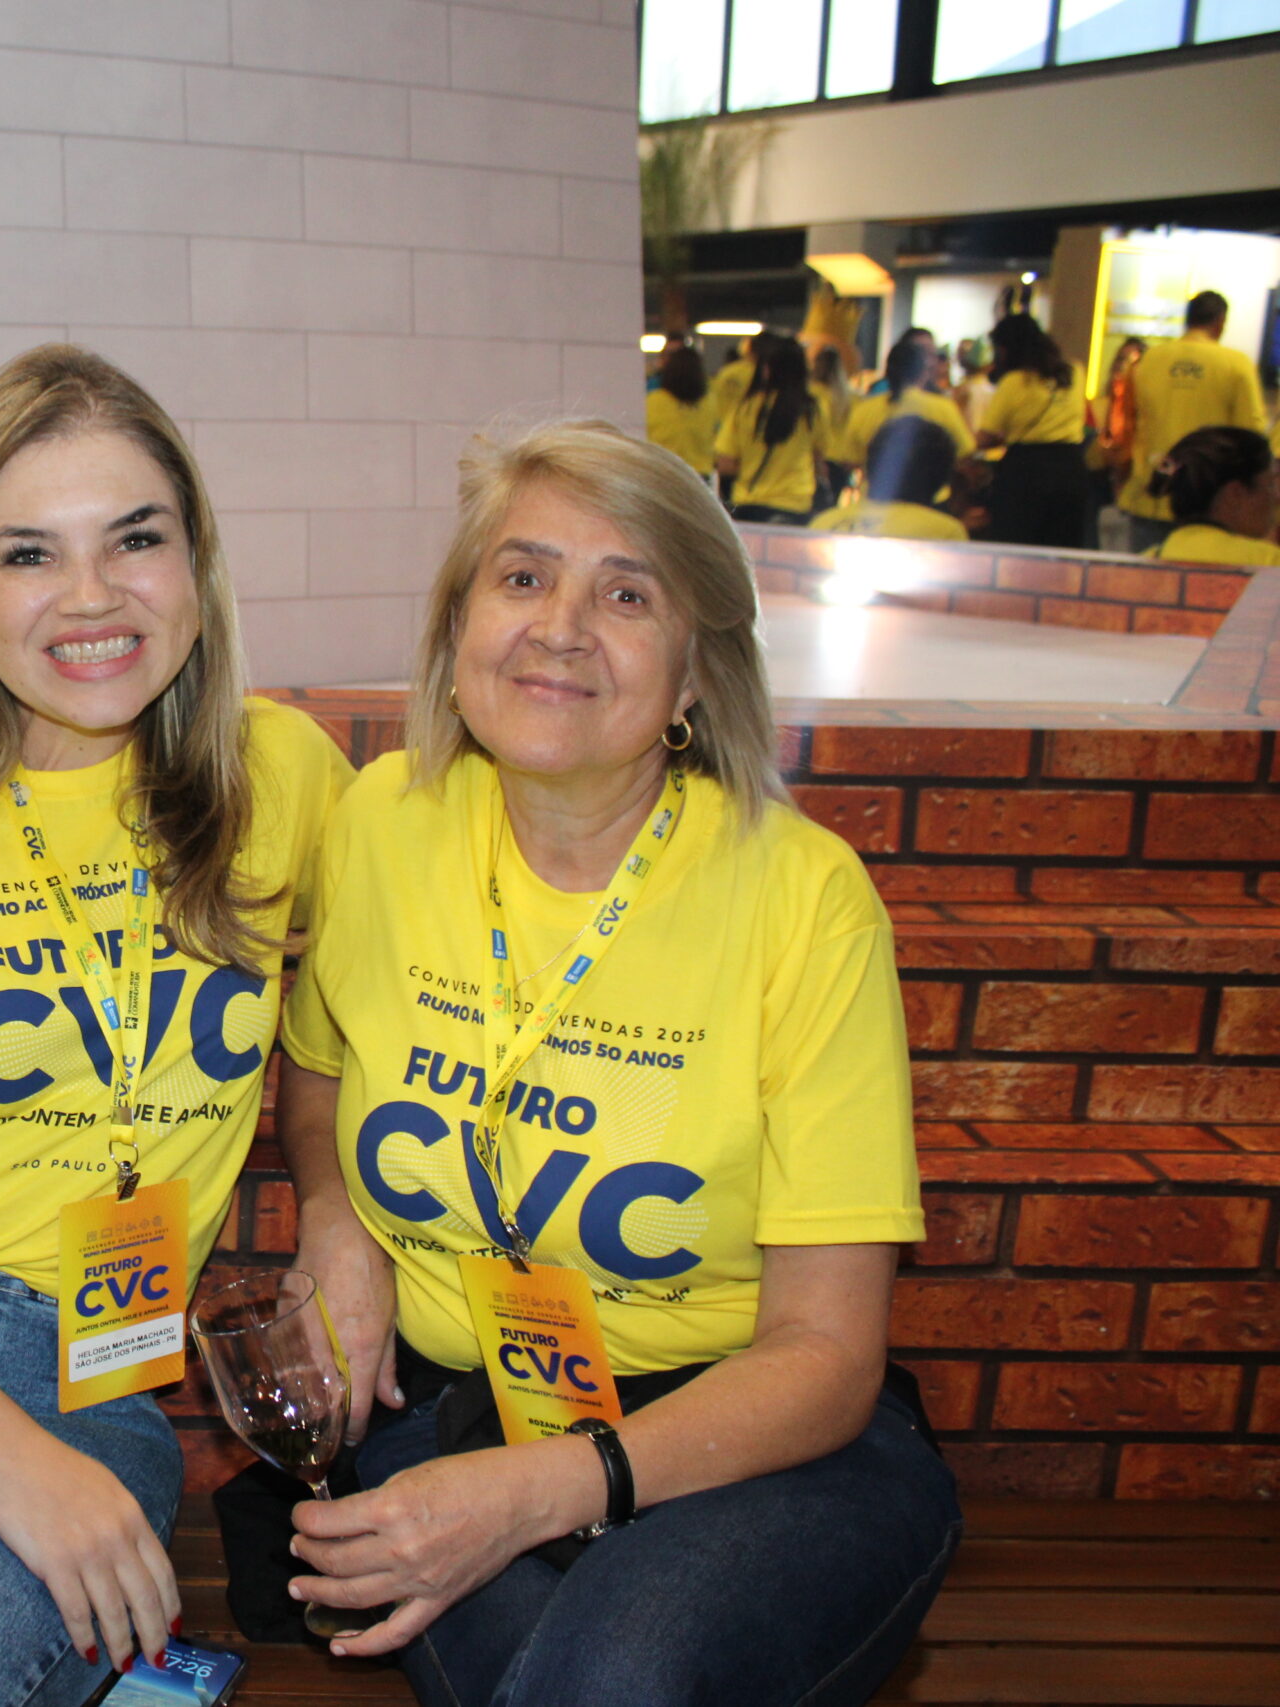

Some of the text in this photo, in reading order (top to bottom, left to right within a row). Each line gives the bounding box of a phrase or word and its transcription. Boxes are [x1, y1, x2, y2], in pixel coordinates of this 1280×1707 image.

[23, 826, 44, 860] CVC
[80, 864, 99, 875] DE
[598, 897, 628, 936] CVC
[417, 991, 469, 1021] RUMO
[595, 1043, 622, 1061] 50
[625, 1050, 685, 1069] ANOS
[559, 1015, 644, 1038] VENDAS
[657, 1027, 705, 1043] 2025
[159, 1106, 173, 1124] E
[51, 1159, 106, 1172] PAULO
[356, 1100, 705, 1280] CVC
[84, 1255, 142, 1279] FUTURO
[75, 1265, 170, 1318] CVC
[111, 1337, 135, 1349] MARIA
[136, 1326, 175, 1342] MACHADO
[113, 1348, 130, 1357] DOS
[130, 1338, 161, 1352] PINHAIS
[165, 1334, 177, 1342] PR
[500, 1327, 559, 1347] FUTURO
[498, 1343, 599, 1393] CVC
[164, 1654, 213, 1678] 7:26
